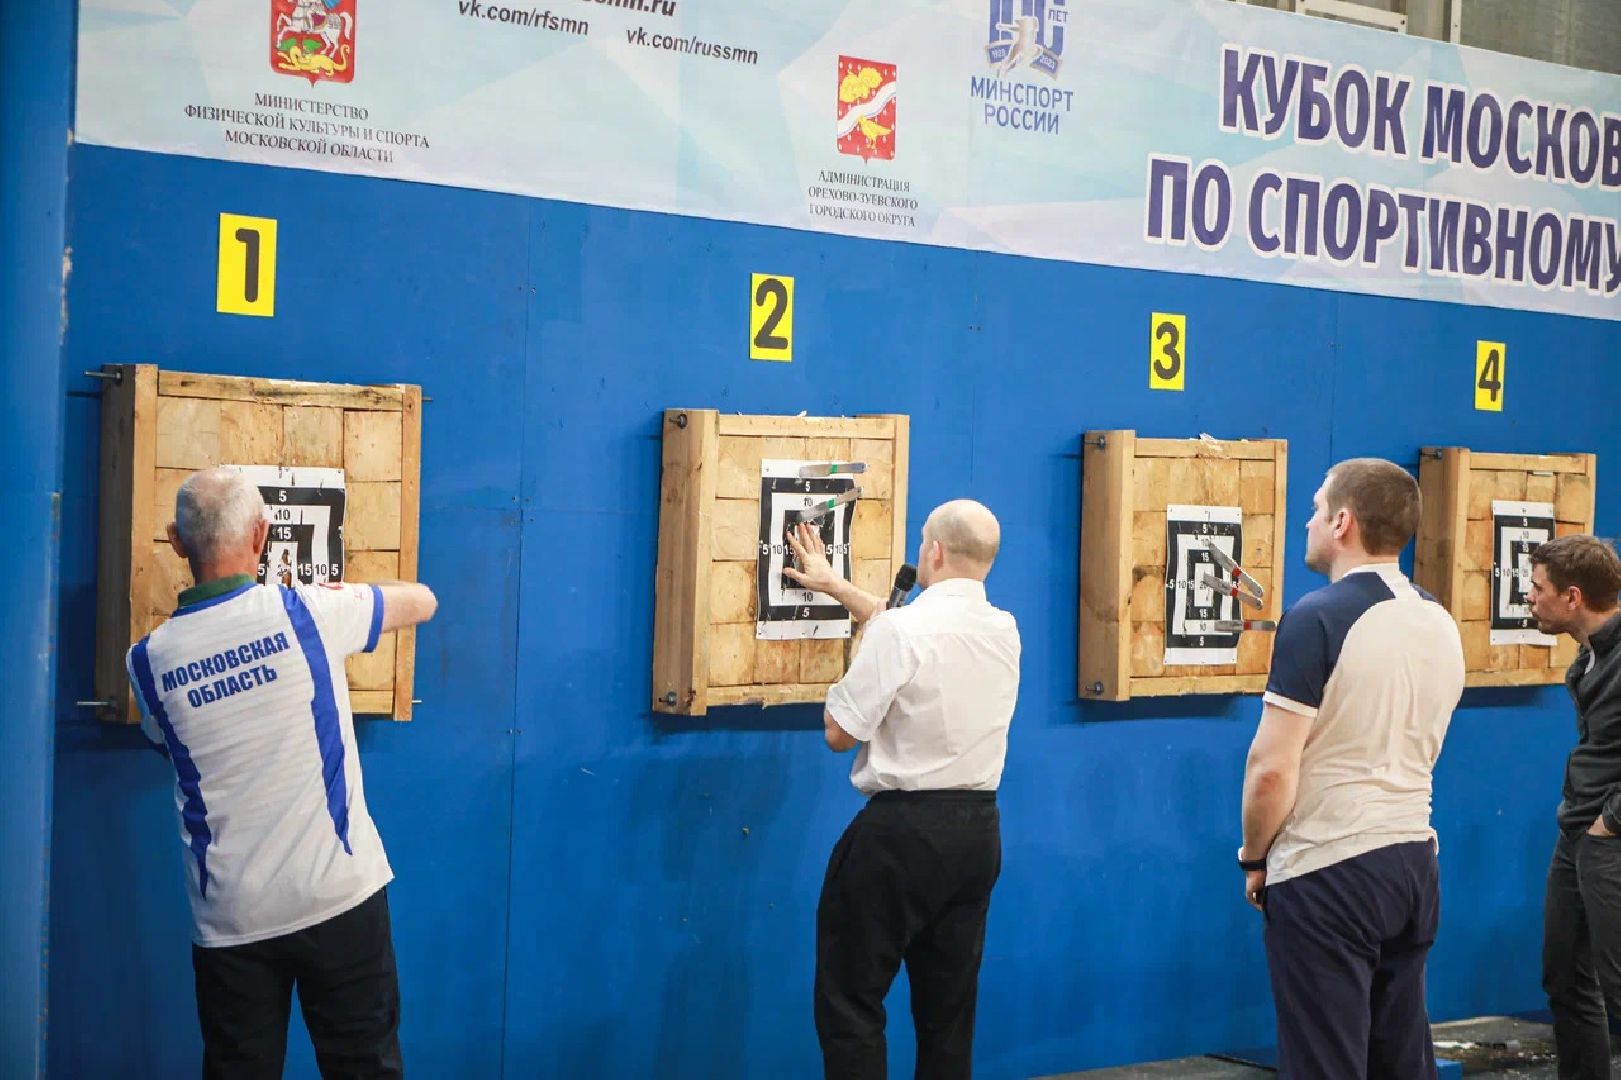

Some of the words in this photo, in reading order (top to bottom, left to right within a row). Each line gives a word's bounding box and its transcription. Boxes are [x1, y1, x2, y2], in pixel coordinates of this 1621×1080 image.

[458, 0, 589, 36] vk.com/rfsmn
[1047, 9, 1069, 23] ЛЕТ
[626, 26, 759, 65] vk.com/russmn
[254, 92, 369, 121] МИНИСТЕРСТВО
[970, 75, 1074, 112] МИНСПОРТ
[183, 104, 286, 130] ФИЗИЧЕСКОЙ
[288, 117, 360, 141] КУЛЬТУРЫ
[363, 128, 374, 141] И
[375, 129, 430, 149] СПОРТА
[984, 102, 1060, 135] РОССИИ
[1221, 47, 1411, 157] КУБОК
[1421, 84, 1621, 188] МОСКОВ
[224, 129, 328, 156] МОСКОВСКОЙ
[330, 143, 393, 163] ОБЛАСТИ
[818, 169, 911, 193] АДМИНИСТРАЦИЯ
[808, 185, 919, 211] ОРЕХОВО-ЗУЕВСКОГО
[1146, 156, 1232, 247] ПО
[808, 203, 877, 222] ГОРОДСКОГО
[879, 213, 916, 228] ОКРУГА
[235, 228, 260, 303] 1
[754, 278, 788, 350] 2
[1154, 321, 1181, 380] 3
[1478, 349, 1502, 402] 4
[278, 489, 288, 503] 5
[805, 480, 811, 493] 5
[277, 508, 291, 521] 10
[277, 526, 293, 540] 15
[762, 543, 769, 556] 5
[772, 544, 783, 556] 10
[299, 563, 313, 577] 15
[315, 563, 328, 577] 10
[330, 563, 340, 576] 5
[802, 591, 814, 602] 10
[161, 632, 291, 693] МОСКОВСКАЯ
[187, 664, 278, 708] ОБЛАСТЬ
